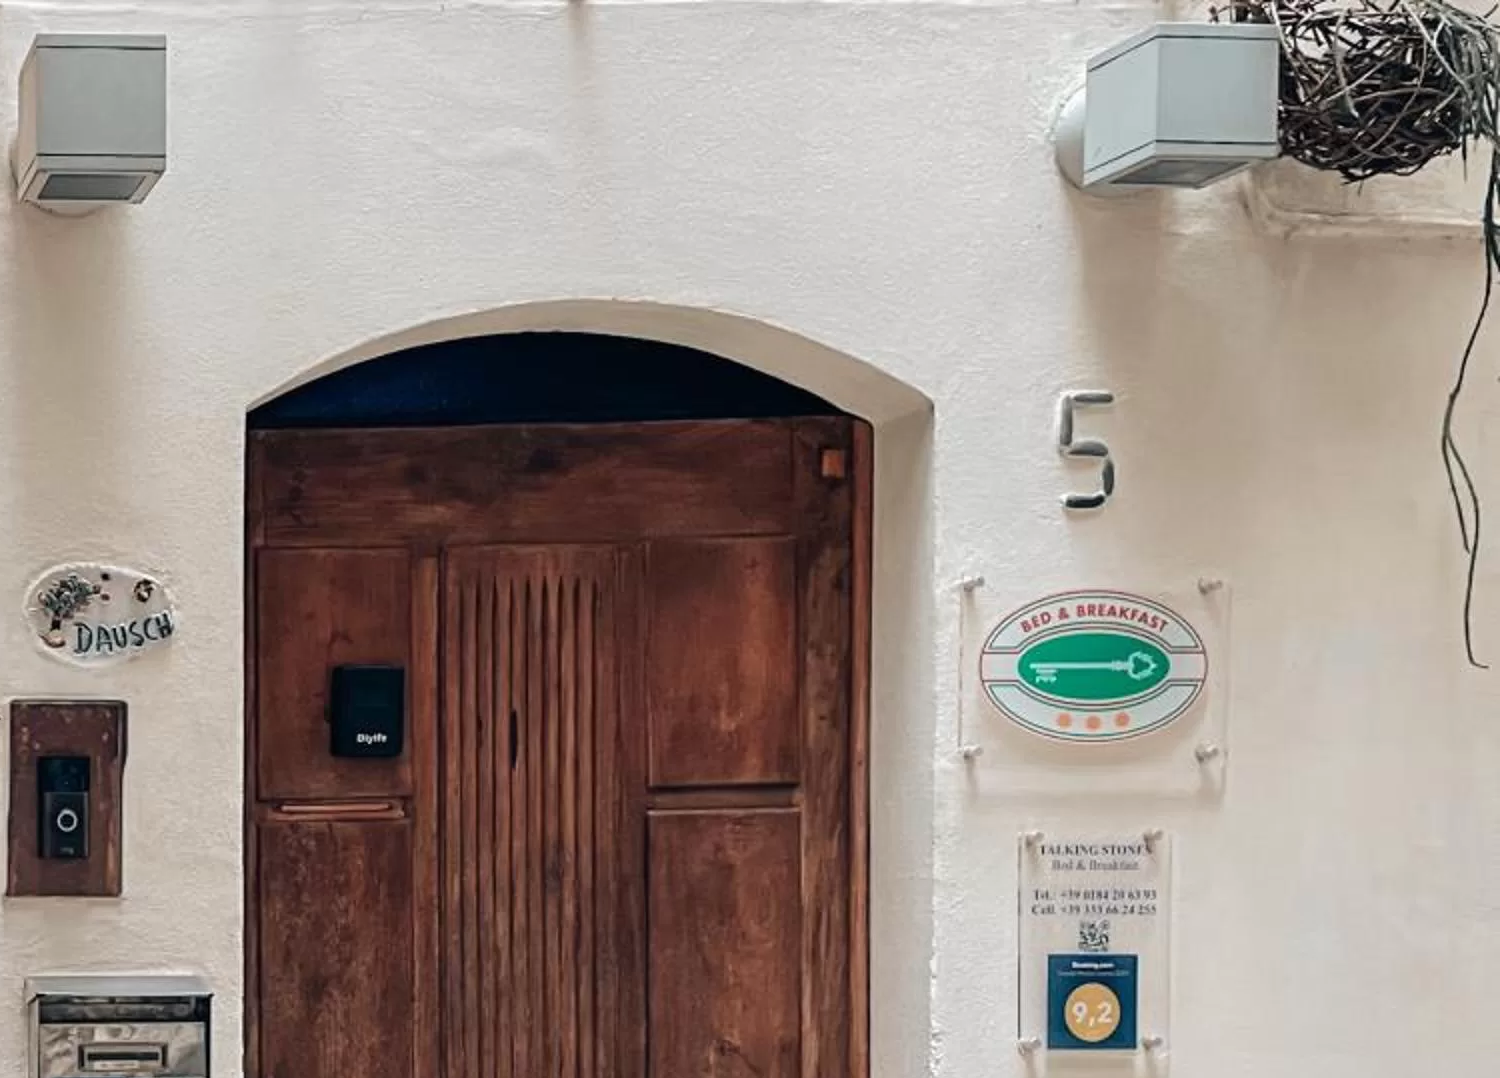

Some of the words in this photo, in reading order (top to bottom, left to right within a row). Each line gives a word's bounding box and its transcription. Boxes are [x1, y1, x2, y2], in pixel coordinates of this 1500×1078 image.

[1057, 389, 1116, 510] 5
[72, 612, 175, 654] DAUSCH
[1020, 610, 1052, 633] BED
[1058, 607, 1070, 621] &
[1076, 603, 1170, 634] BREAKFAST
[1040, 844, 1099, 857] TALKING
[1102, 844, 1151, 856] STONE
[1071, 1001, 1113, 1027] 9,2
